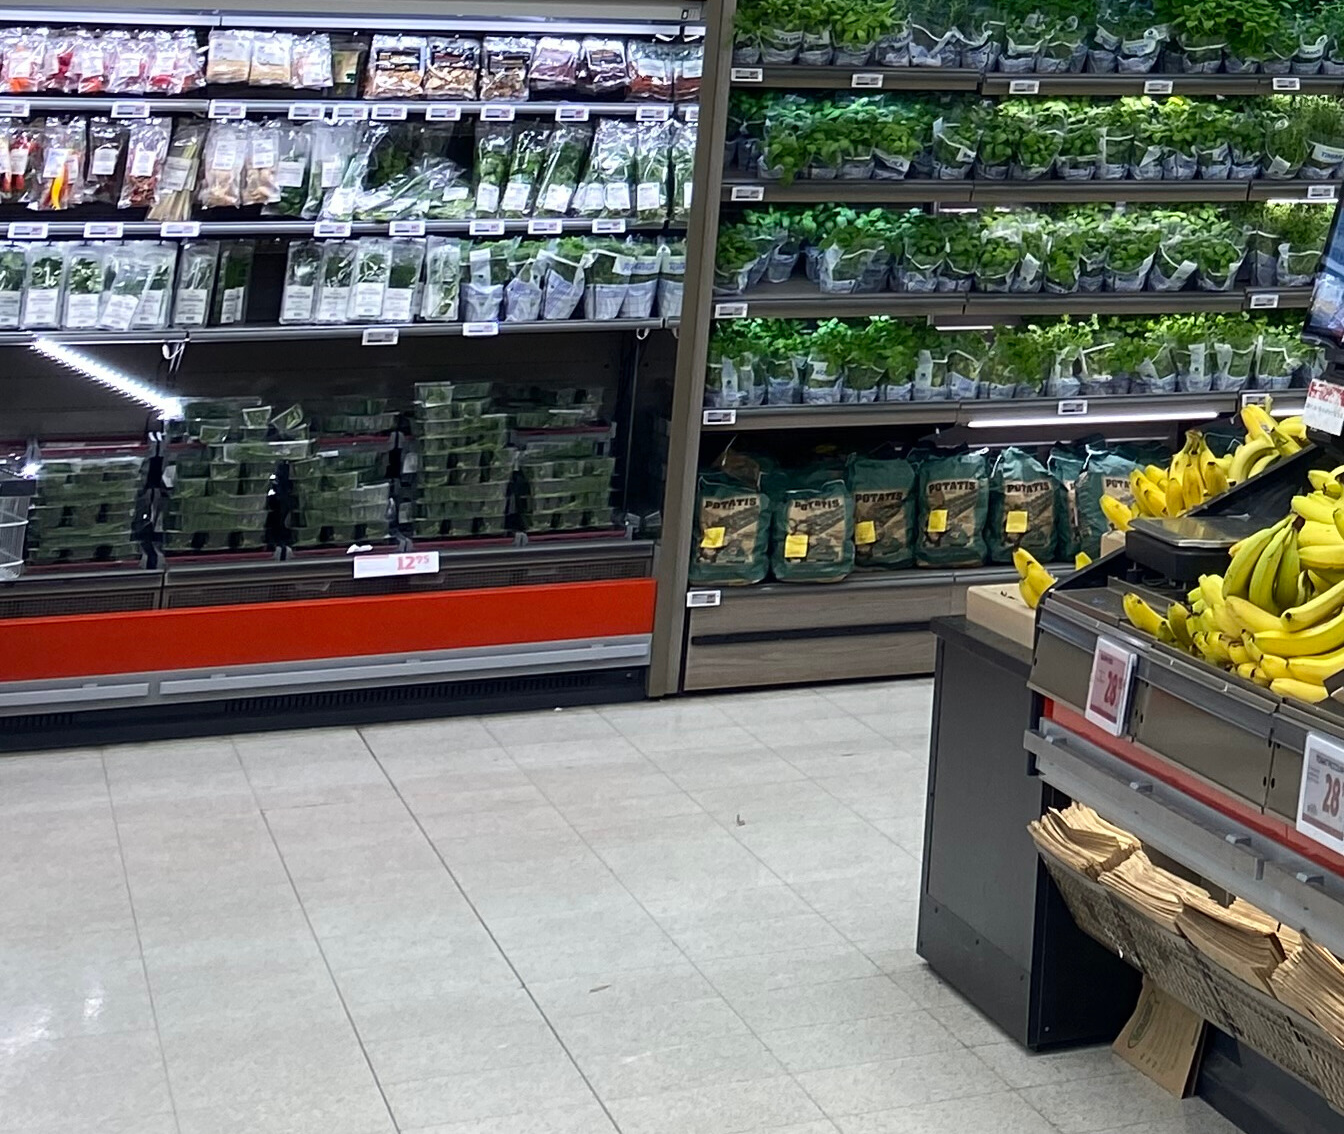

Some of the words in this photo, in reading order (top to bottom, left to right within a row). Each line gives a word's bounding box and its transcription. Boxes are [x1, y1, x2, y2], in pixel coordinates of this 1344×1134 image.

[928, 480, 976, 494] POTATIS
[1006, 481, 1050, 493] POTATIS
[1106, 478, 1130, 488] POTA
[704, 497, 757, 509] POTATIS
[855, 491, 903, 503] POTATIS
[794, 499, 840, 511] POTATIS
[397, 556, 415, 570] 12
[1322, 773, 1341, 817] 28
